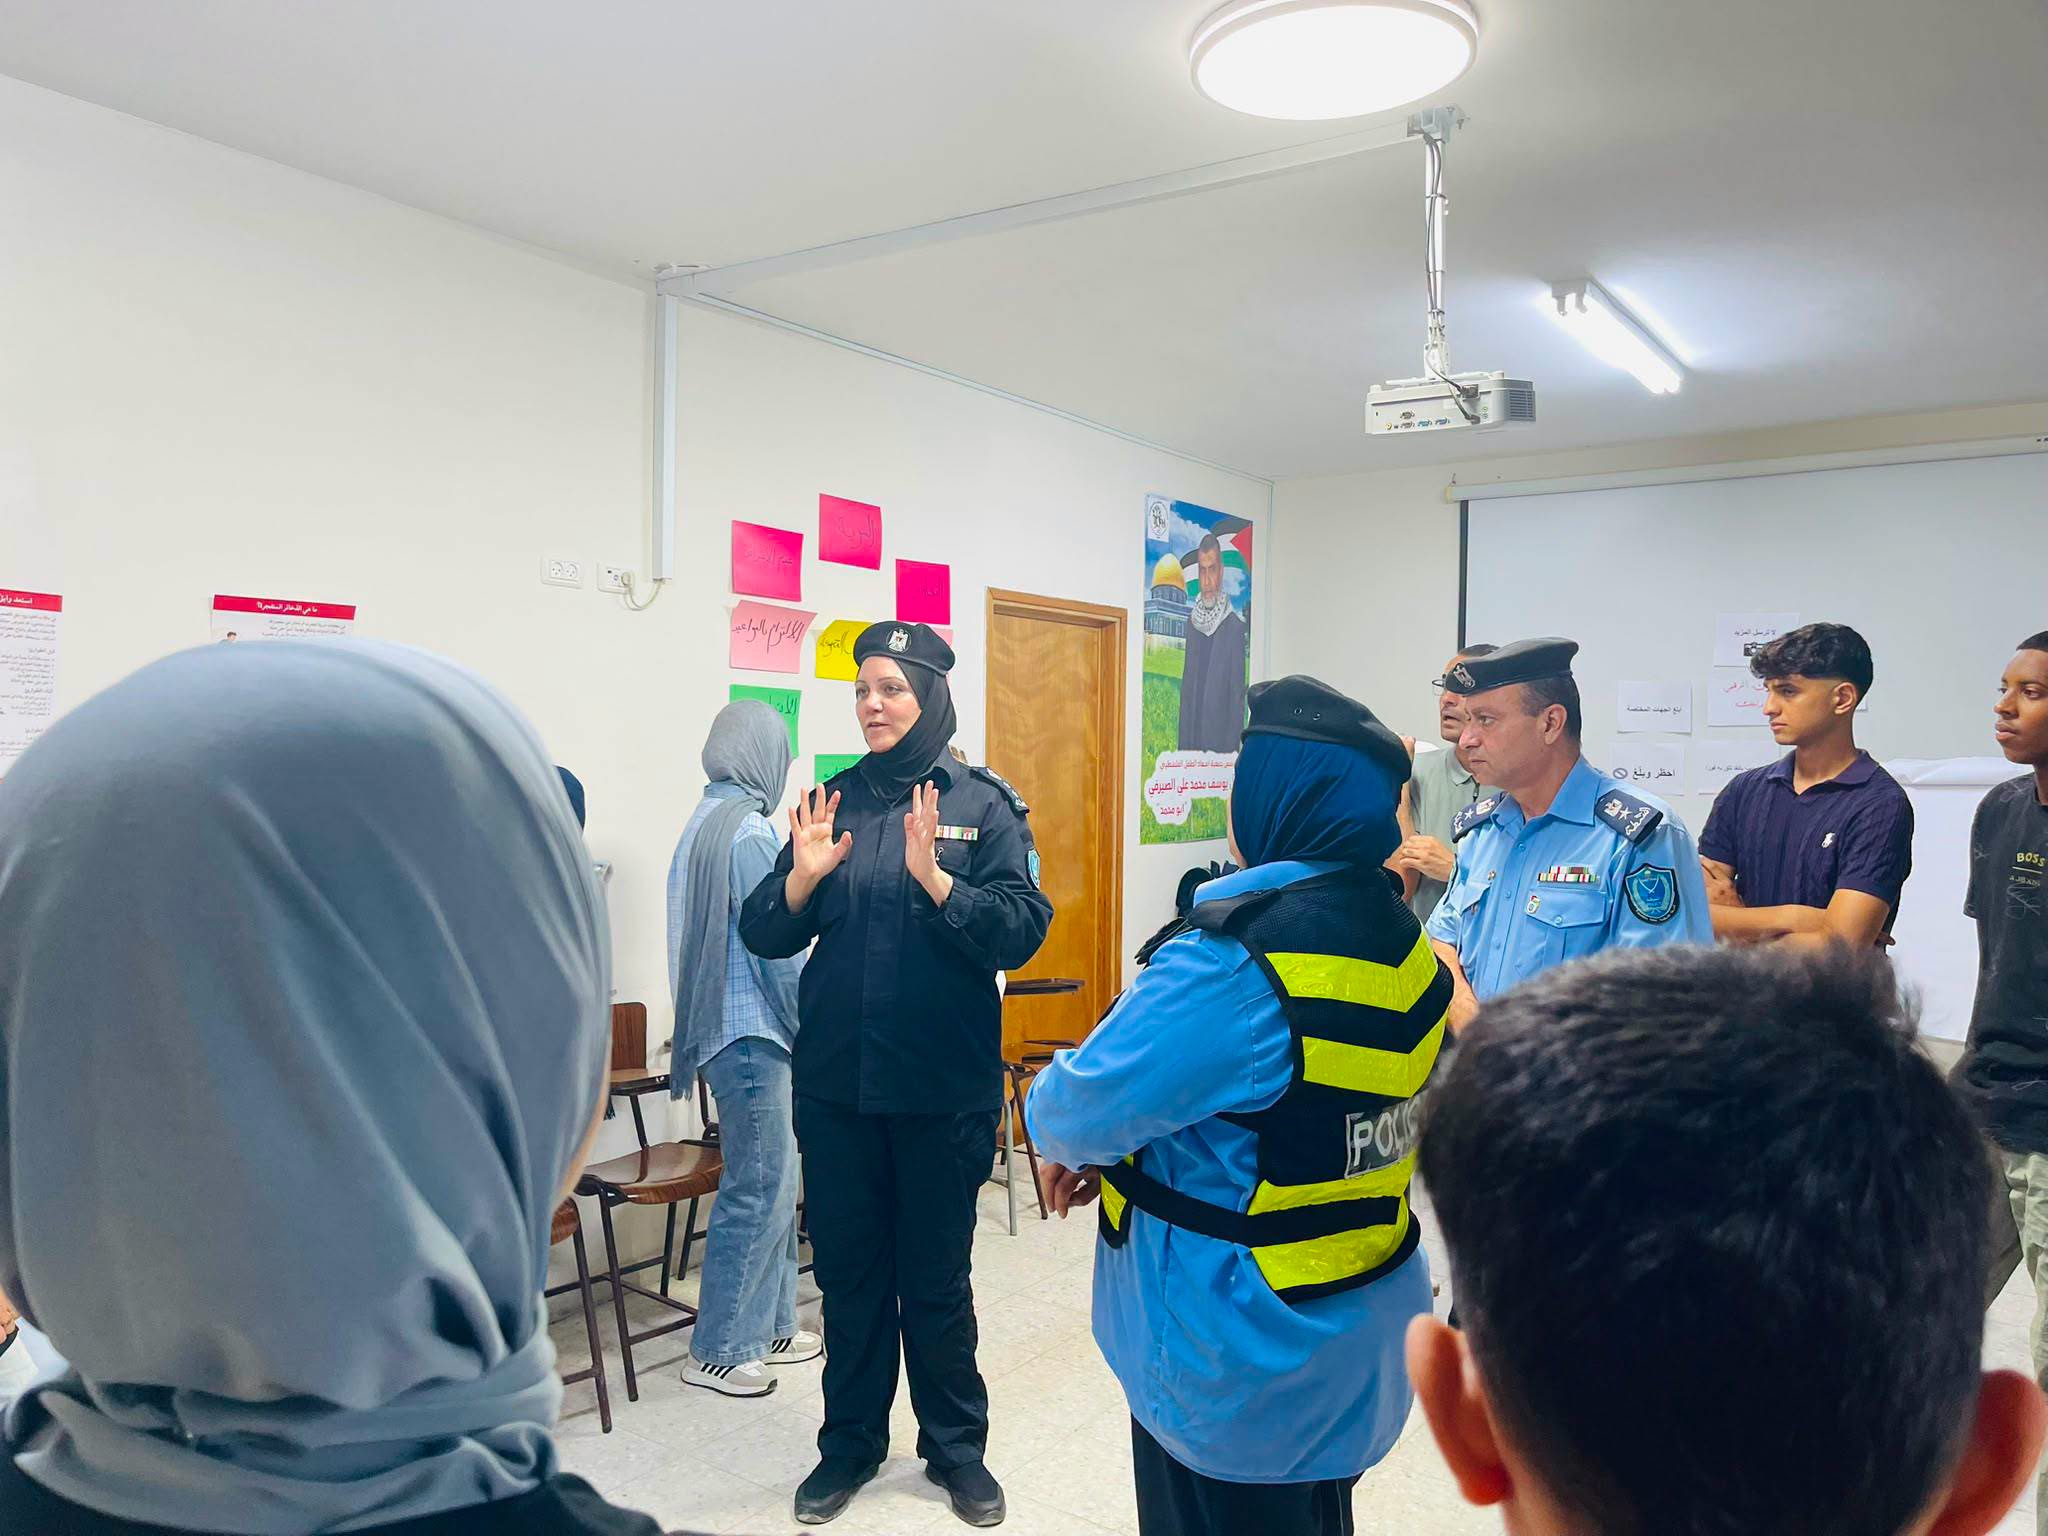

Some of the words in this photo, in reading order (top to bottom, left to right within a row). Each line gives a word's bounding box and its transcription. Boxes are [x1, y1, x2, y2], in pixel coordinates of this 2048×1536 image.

[1148, 778, 1176, 797] الصيرفي
[1177, 778, 1189, 796] علي
[1190, 780, 1207, 790] محمد
[1208, 779, 1229, 791] يوسف
[2017, 852, 2046, 867] BOSS
